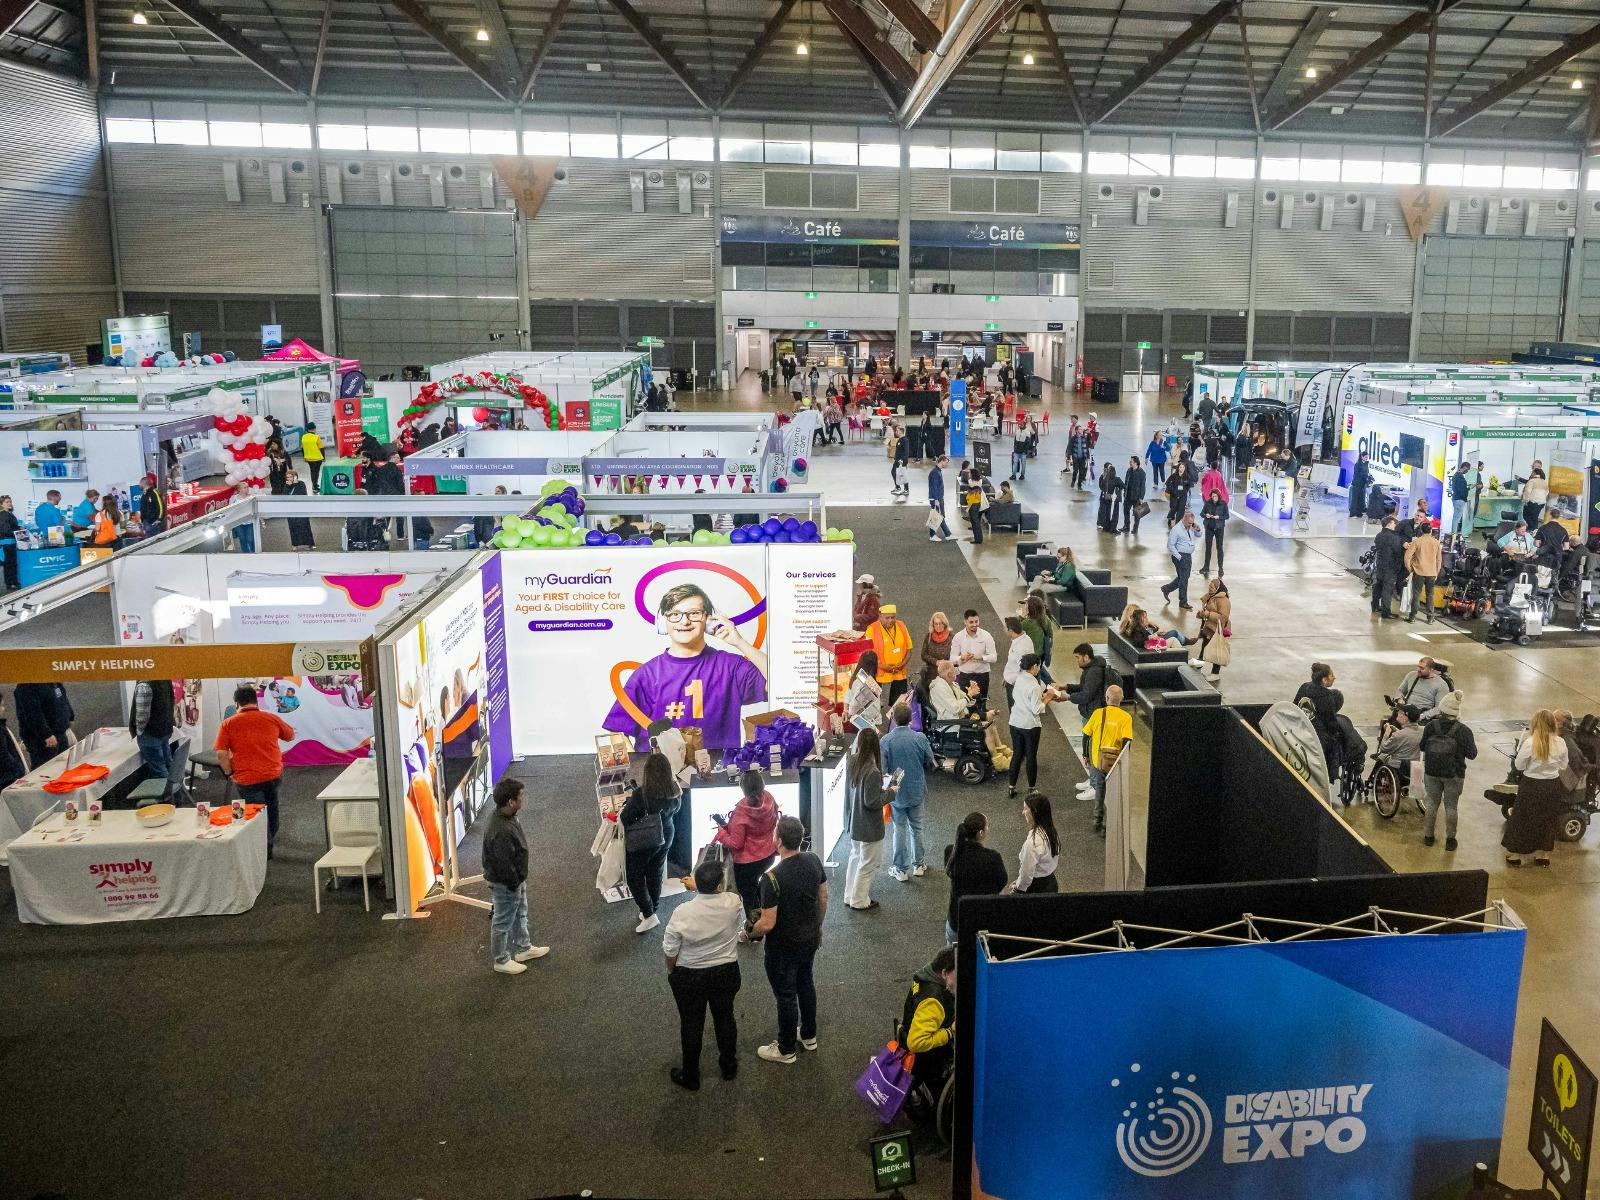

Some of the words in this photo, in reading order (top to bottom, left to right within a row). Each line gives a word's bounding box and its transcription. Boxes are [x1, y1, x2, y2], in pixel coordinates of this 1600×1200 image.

[804, 221, 842, 237] Café
[989, 225, 1025, 241] Café
[1305, 382, 1321, 436] FREEDOM
[39, 554, 66, 564] CIVIC
[524, 572, 612, 589] myGuardian
[785, 571, 800, 579] Our
[802, 571, 837, 579] Services
[518, 593, 541, 602] Your
[543, 592, 570, 601] FIRST
[572, 591, 606, 600] choice
[607, 591, 621, 600] for
[515, 603, 542, 614] Aged
[554, 602, 600, 613] Disability
[601, 602, 626, 611] Care
[535, 621, 606, 631] myguardian.com.au
[52, 659, 99, 671] SIMPLY
[101, 658, 156, 670] HELPING
[328, 661, 361, 670] EXPO
[89, 858, 153, 875] simply
[113, 874, 158, 886] helping
[104, 895, 123, 903] 1800
[1225, 1083, 1374, 1124] DISABILITY
[1539, 1096, 1582, 1162] TOILETS
[1223, 1116, 1367, 1164] EXPO
[877, 1161, 911, 1175] CHECK-IN
